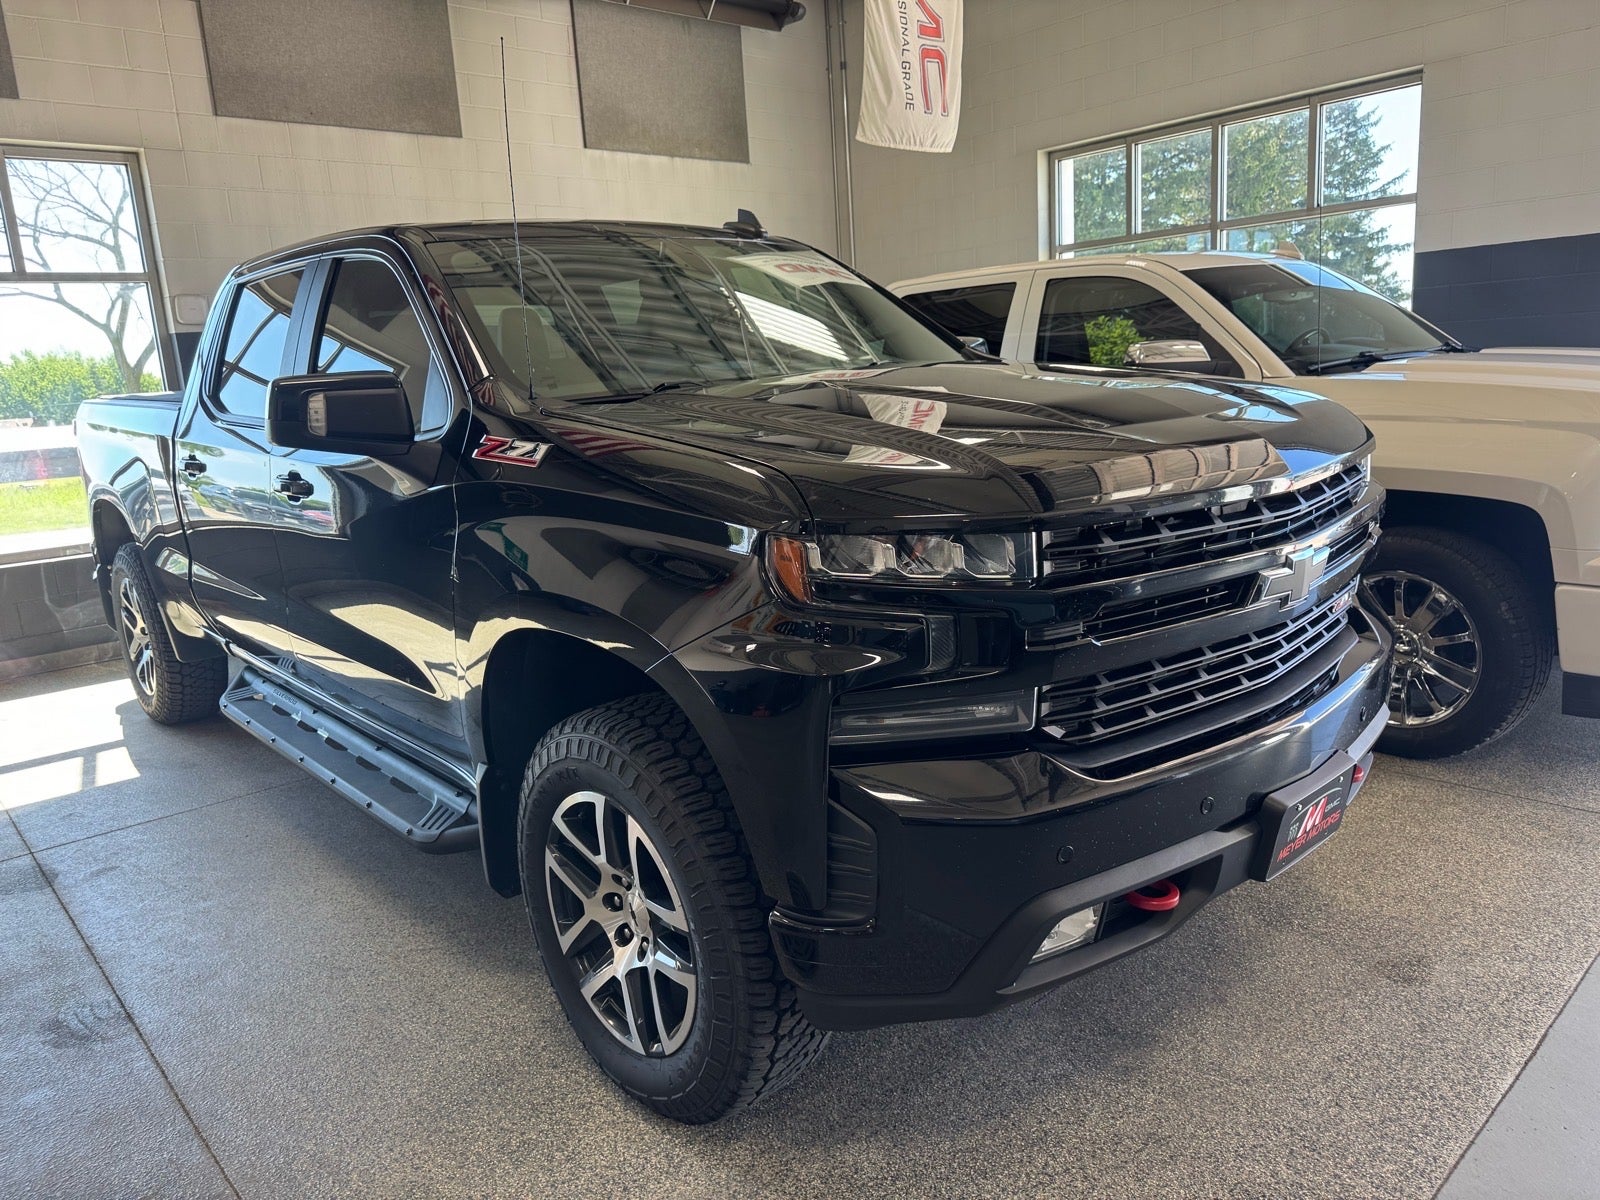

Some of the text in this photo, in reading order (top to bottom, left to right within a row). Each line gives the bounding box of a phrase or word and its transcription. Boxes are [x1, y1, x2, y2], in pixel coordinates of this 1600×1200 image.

[901, 60, 915, 112] GRADE
[472, 434, 554, 468] Z71
[1277, 809, 1341, 863] MEYER MOTORS
